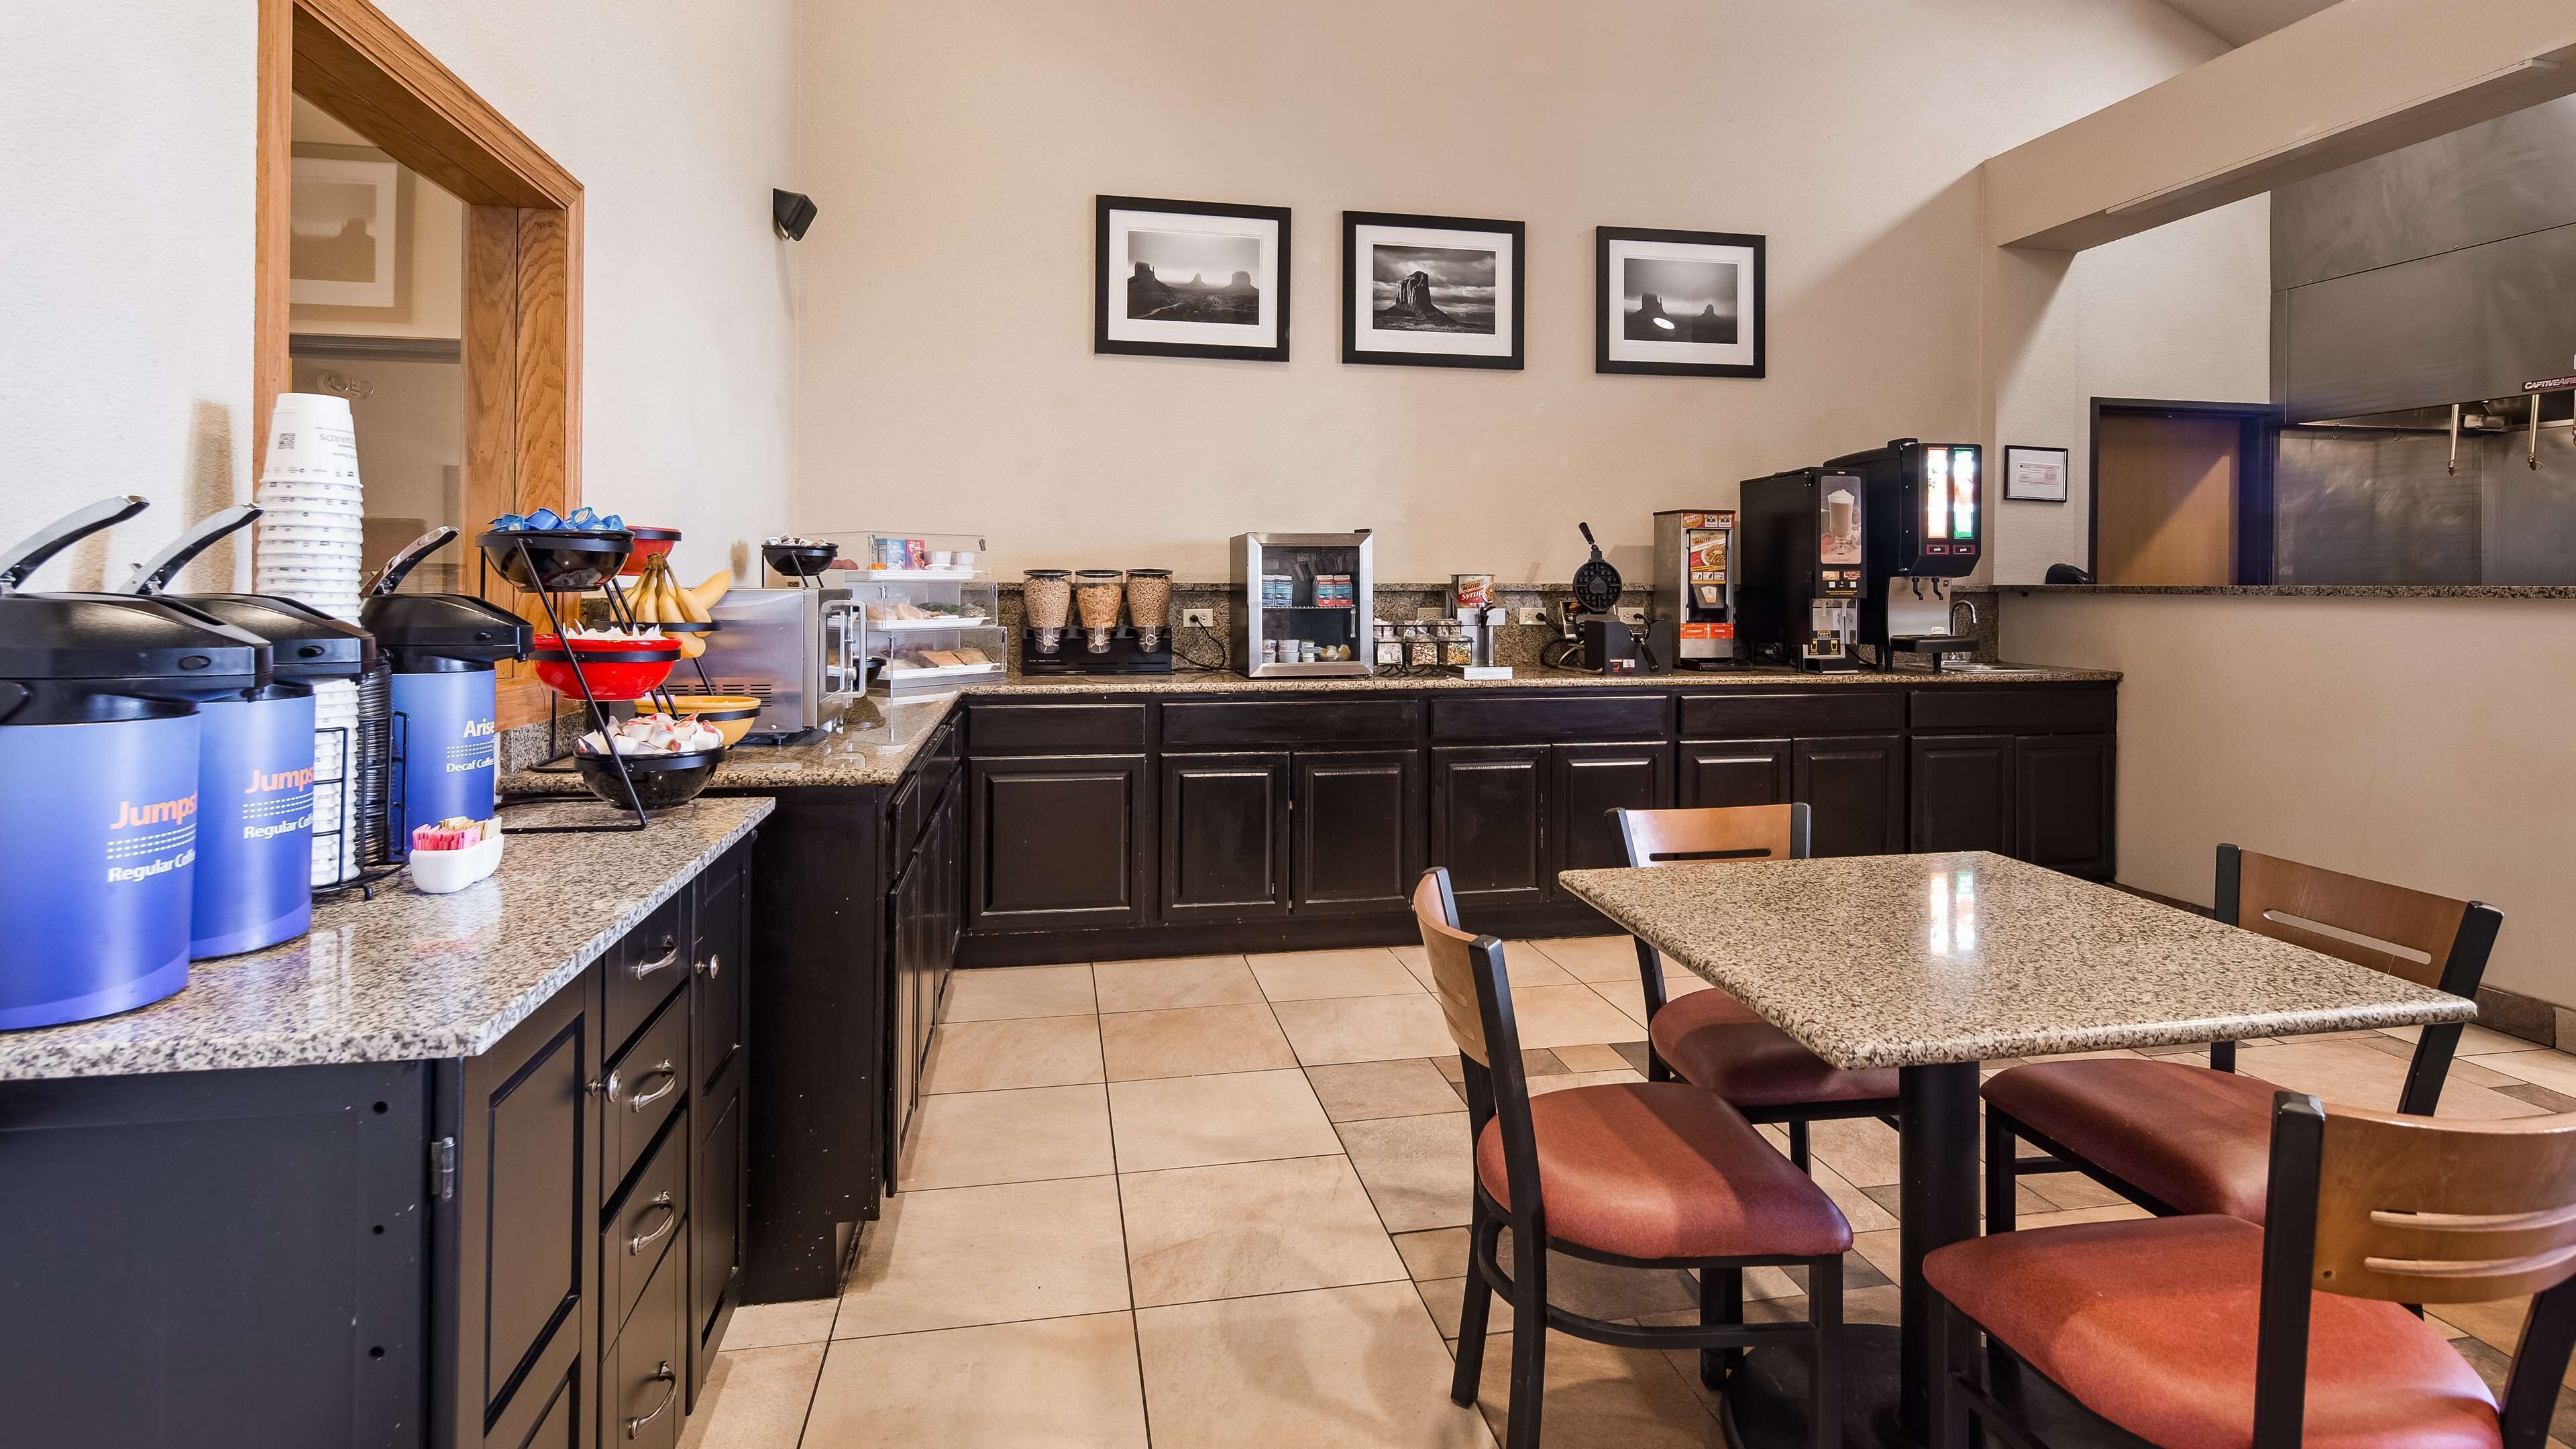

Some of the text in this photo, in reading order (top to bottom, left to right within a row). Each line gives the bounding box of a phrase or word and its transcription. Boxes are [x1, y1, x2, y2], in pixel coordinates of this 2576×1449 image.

[1461, 590, 1483, 600] Syrup
[446, 759, 476, 773] Decaf
[109, 790, 198, 830] Jumps
[244, 820, 298, 839] Regular
[107, 859, 174, 883] Regular
